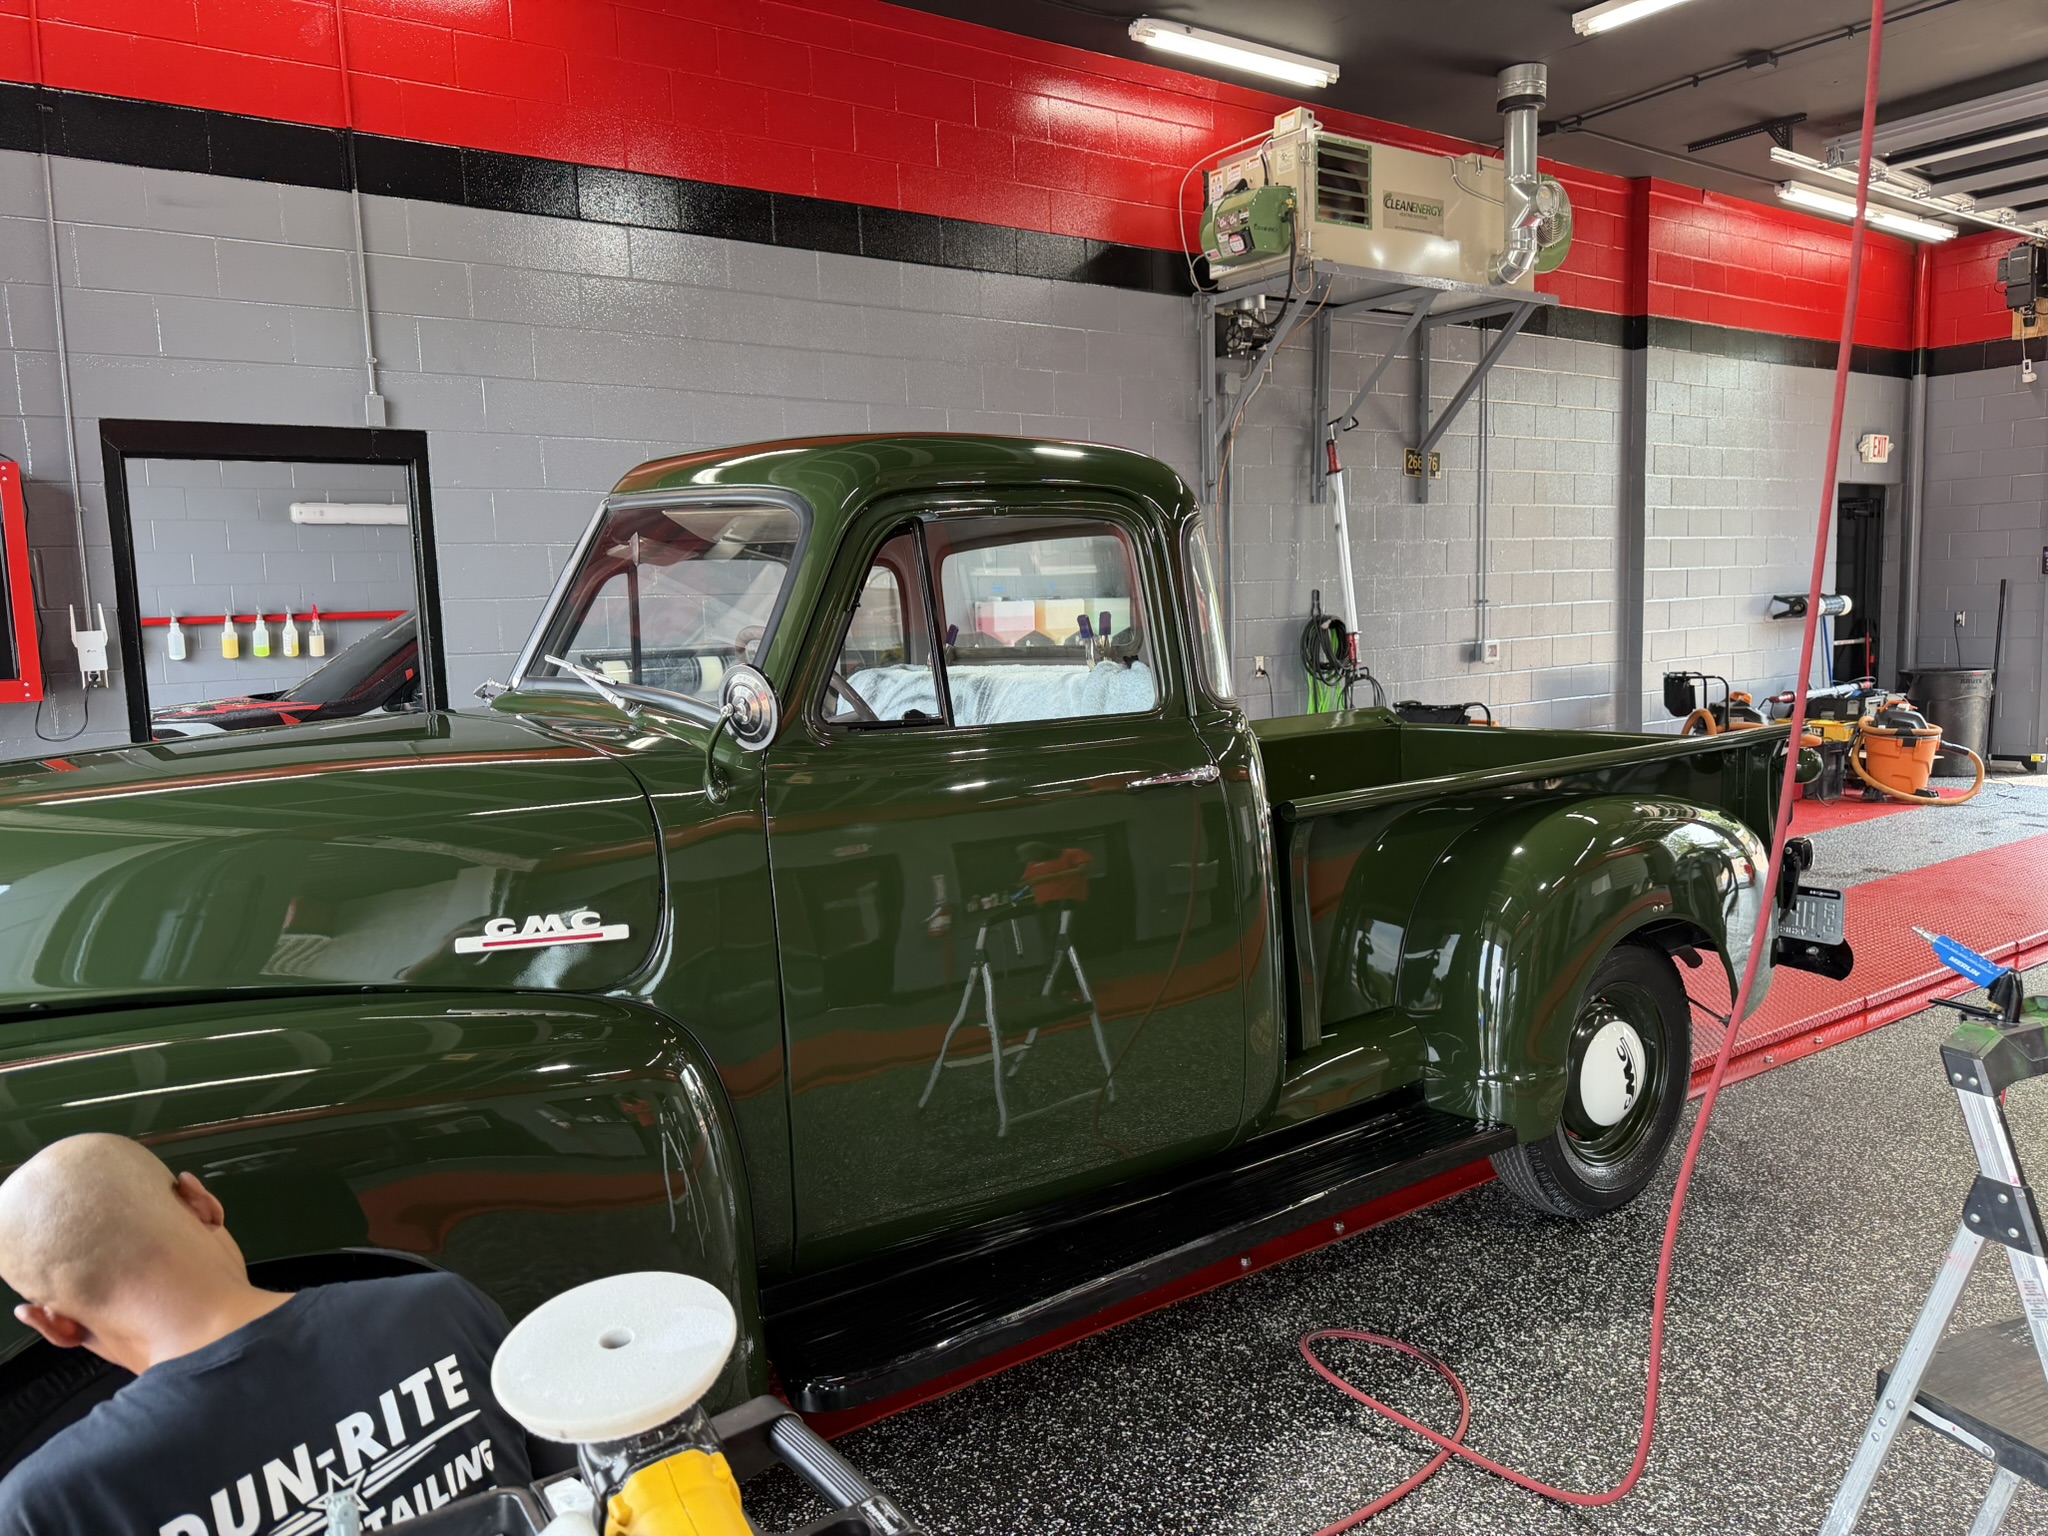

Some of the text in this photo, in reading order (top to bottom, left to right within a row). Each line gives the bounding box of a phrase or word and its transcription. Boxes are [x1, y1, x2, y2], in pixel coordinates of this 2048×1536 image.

[1384, 198, 1443, 217] CLEANENERGY
[1873, 436, 1887, 458] EXIT
[1407, 454, 1438, 471] 26876
[484, 911, 601, 937] GMC
[1948, 956, 1981, 977] MERLIN
[358, 1439, 495, 1532] TAILING
